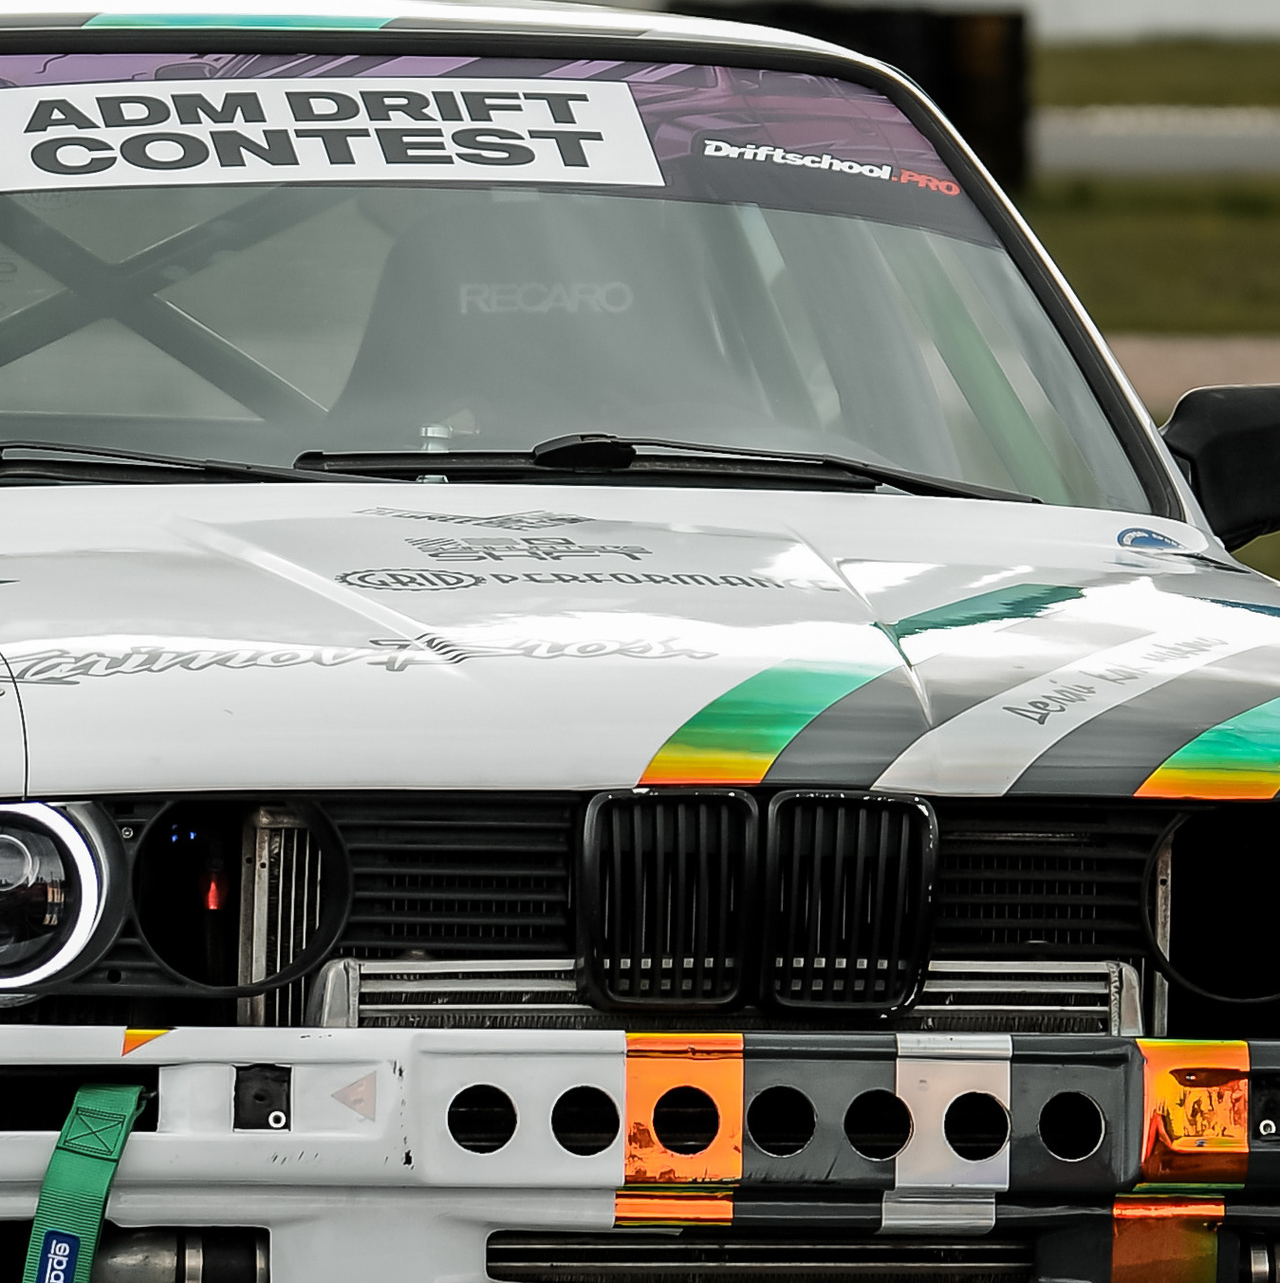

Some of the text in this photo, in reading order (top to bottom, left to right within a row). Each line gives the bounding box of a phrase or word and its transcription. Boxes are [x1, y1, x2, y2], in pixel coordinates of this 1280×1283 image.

[23, 89, 591, 134] ADM DRIFT
[29, 127, 604, 177] CONTEST
[459, 281, 633, 316] RECARO
[357, 571, 466, 589] GRID
